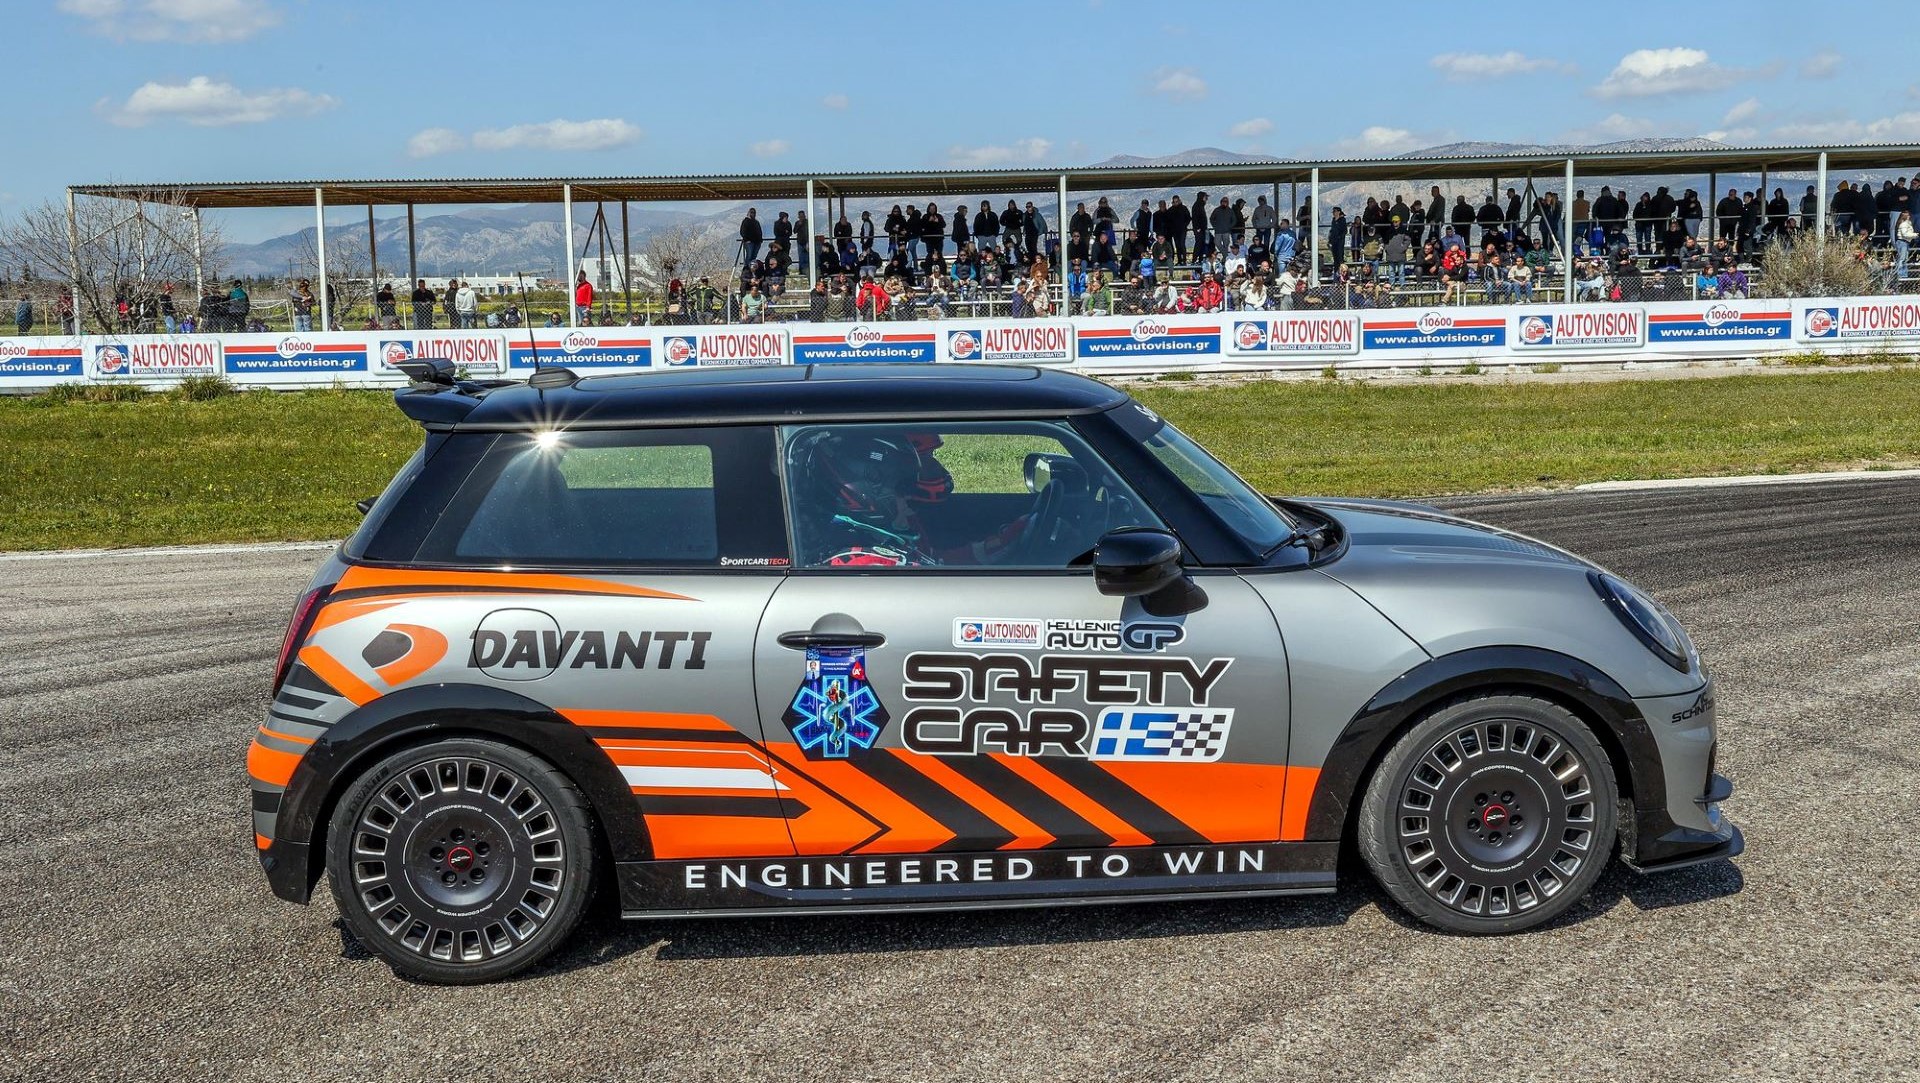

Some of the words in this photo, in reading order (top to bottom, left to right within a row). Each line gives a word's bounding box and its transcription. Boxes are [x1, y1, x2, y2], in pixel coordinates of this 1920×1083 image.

[1711, 310, 1738, 320] 10600
[1842, 305, 1920, 329] AUTOVISION
[1424, 317, 1451, 327] 10600
[1556, 312, 1637, 336] AUTOVISION
[1138, 325, 1166, 335] 10600
[1271, 319, 1351, 344] AUTOVISION
[1661, 325, 1781, 337] www.autovision.gr
[569, 338, 596, 346] 10600
[853, 332, 880, 341] 10600
[985, 328, 1066, 352] AUTOVISION
[1375, 333, 1494, 344] www.autovision.gr
[285, 342, 311, 351] 10600
[418, 339, 497, 361] AUTOVISION
[701, 334, 781, 358] AUTOVISION
[1090, 342, 1209, 352] www.autovision.gr
[133, 343, 213, 367] AUTOVISION
[805, 348, 924, 358] www.autovision.gr
[0, 362, 71, 372] tovision.gr
[237, 358, 356, 368] www.autovision.gr
[985, 624, 1037, 638] AUTOVISION
[1048, 622, 1121, 631] HELLENIC
[467, 630, 712, 669] DAVANTI
[904, 654, 1234, 704] SAFETY
[903, 708, 1088, 756] CAR
[425, 809, 439, 818] JOHN
[686, 858, 1033, 888] ENGINEERED
[1067, 856, 1129, 878] TO
[1164, 850, 1264, 874] WIN
